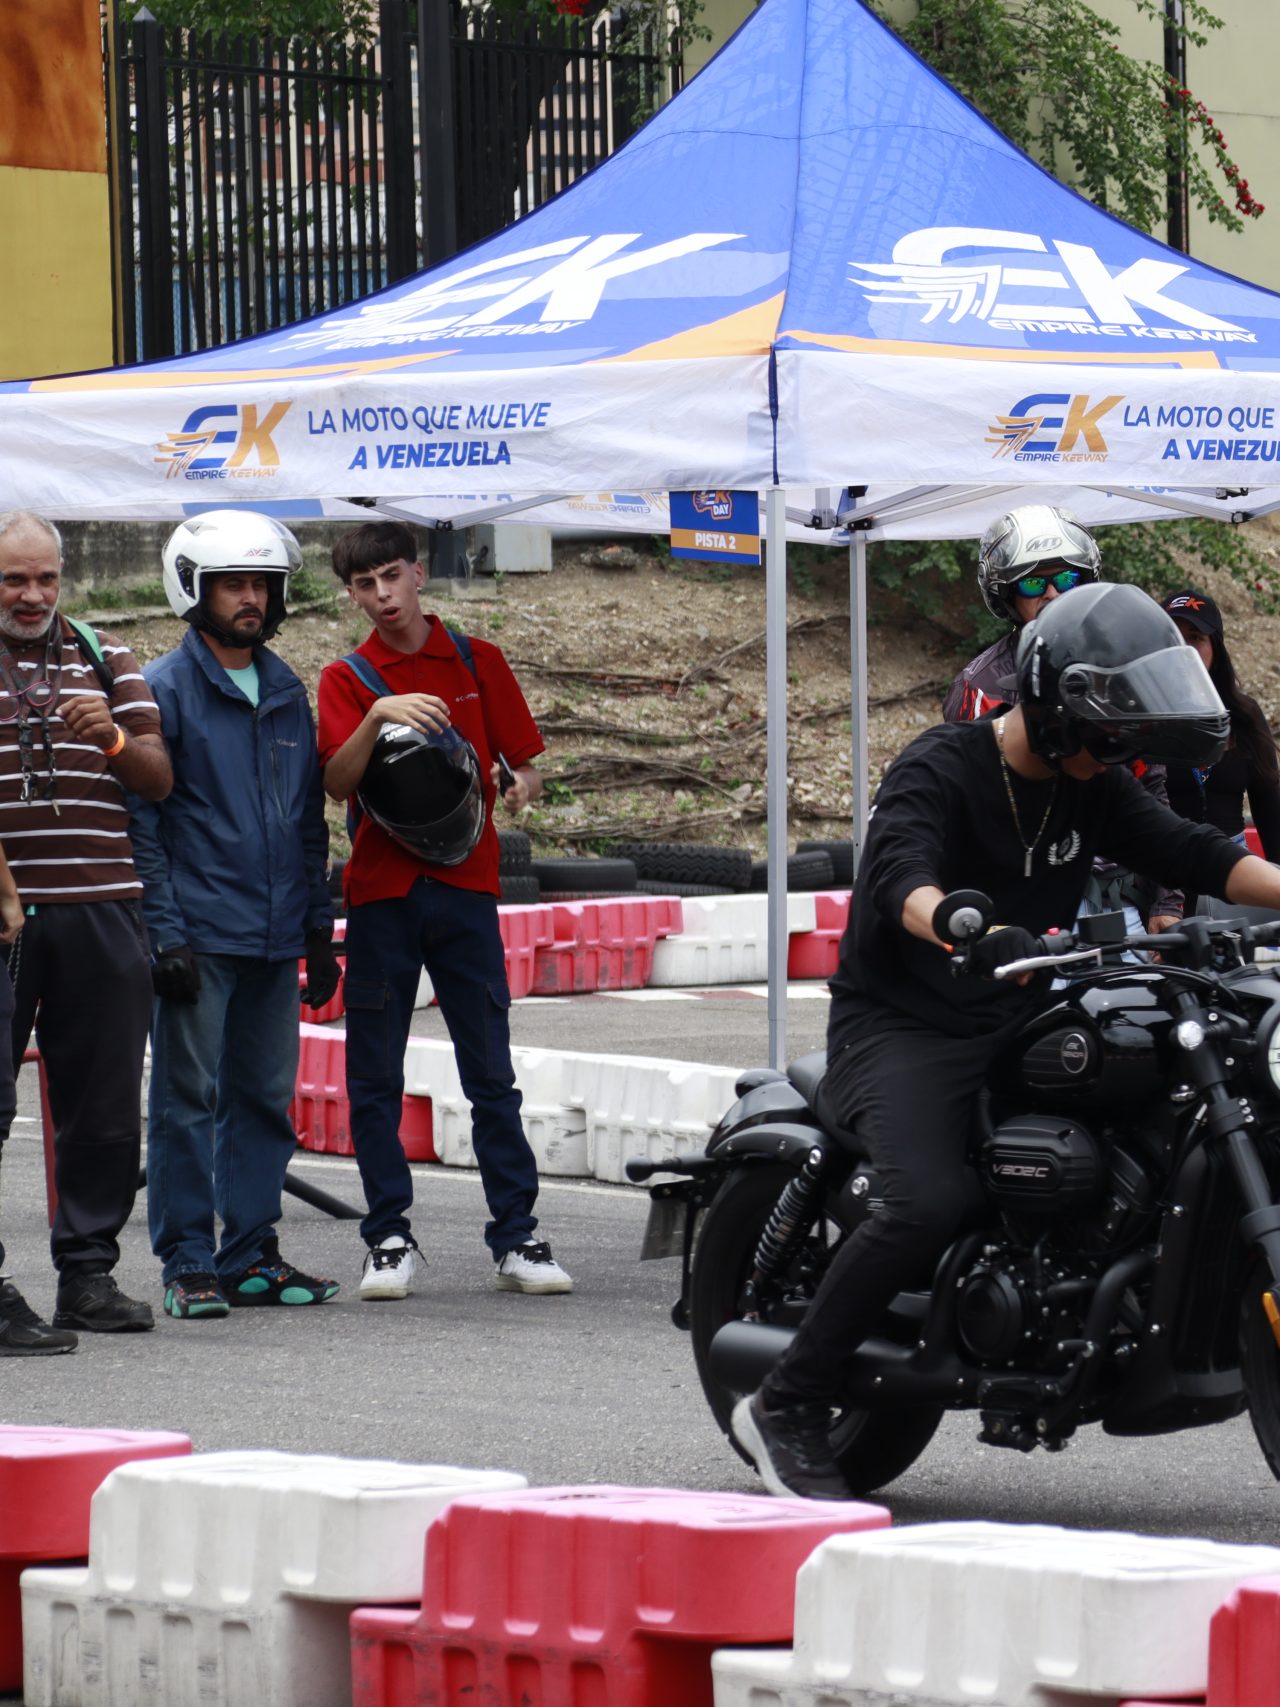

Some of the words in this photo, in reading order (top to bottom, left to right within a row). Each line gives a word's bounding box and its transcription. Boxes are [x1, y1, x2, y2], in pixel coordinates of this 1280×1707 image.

[878, 227, 1251, 333] EK
[325, 327, 450, 350] EMPIRE
[449, 320, 586, 341] KEEWAY
[989, 319, 1126, 337] EMPIRE
[1132, 326, 1259, 344] KEEWAY
[308, 410, 336, 435] LA
[342, 407, 409, 433] MOTO
[412, 405, 460, 435] QUE
[466, 402, 552, 429] MUEVE
[998, 393, 1126, 453] EK
[1123, 405, 1151, 428] LA
[1156, 406, 1223, 429] MOTO
[1226, 407, 1275, 433] QUE
[170, 401, 292, 468] EK
[348, 446, 368, 471] A
[377, 440, 511, 470] VENEZUELA
[1014, 453, 1061, 462] EMPIRE
[1061, 453, 1108, 463] KEEWAY
[1162, 438, 1180, 460] A
[185, 469, 226, 481] EMPIRE
[229, 466, 279, 480] KEEWAY
[713, 504, 729, 515] DAY
[695, 532, 727, 549] PISTA
[728, 536, 736, 549] 2
[992, 1164, 1049, 1178] V302C
